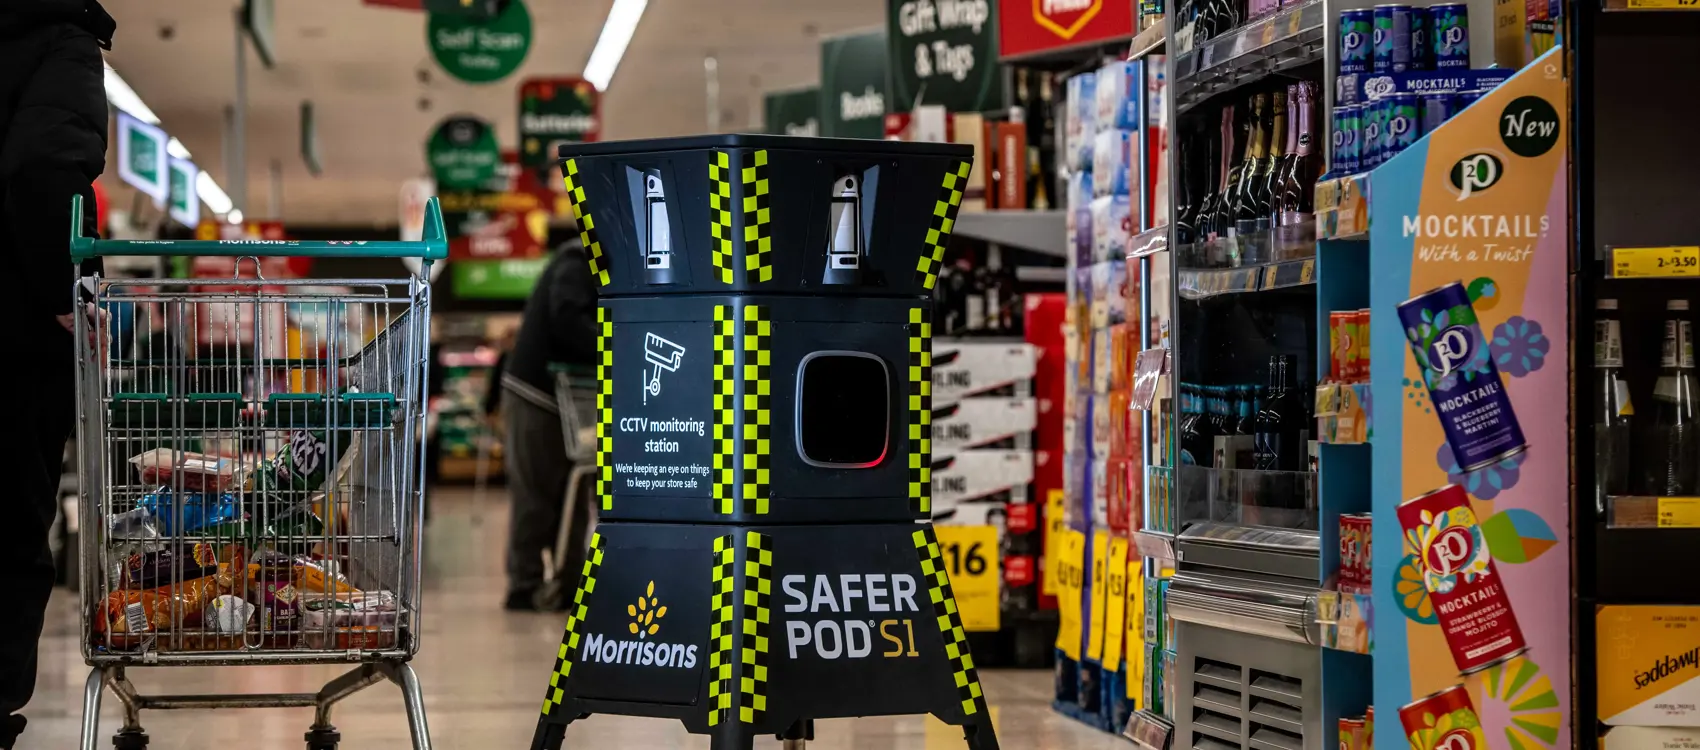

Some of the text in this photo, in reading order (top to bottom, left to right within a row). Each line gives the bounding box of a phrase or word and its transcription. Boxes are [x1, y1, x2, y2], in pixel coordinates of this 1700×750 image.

[899, 0, 988, 36] Gift Wrap
[914, 41, 974, 81] & Tags
[1406, 77, 1466, 90] MOCKTAILS
[840, 85, 885, 120] Books
[1504, 108, 1556, 137] New
[1402, 214, 1550, 239] MOCKTAILS
[1418, 243, 1533, 262] With a Twist
[1657, 257, 1664, 268] 2
[1438, 381, 1499, 413] MOCKTAILS
[1453, 401, 1498, 423] BLACKBERRY
[1462, 408, 1501, 428] BLUEBERRY
[620, 417, 705, 437] CCTV monitoring
[1463, 417, 1500, 435] MARTINI
[644, 437, 679, 453] station
[615, 462, 710, 477] We're keeping an eye on things
[626, 476, 698, 491] to keep your store safe
[781, 573, 920, 613] SAFER
[1438, 583, 1499, 615] MOCKTAILS
[1449, 604, 1496, 626] STRAWBERRY
[880, 619, 920, 658] S1
[1448, 620, 1476, 635] ORANGE
[1465, 620, 1498, 637] MOJITO
[581, 630, 698, 670] Morrisons
[1634, 646, 1700, 690] hweppes
